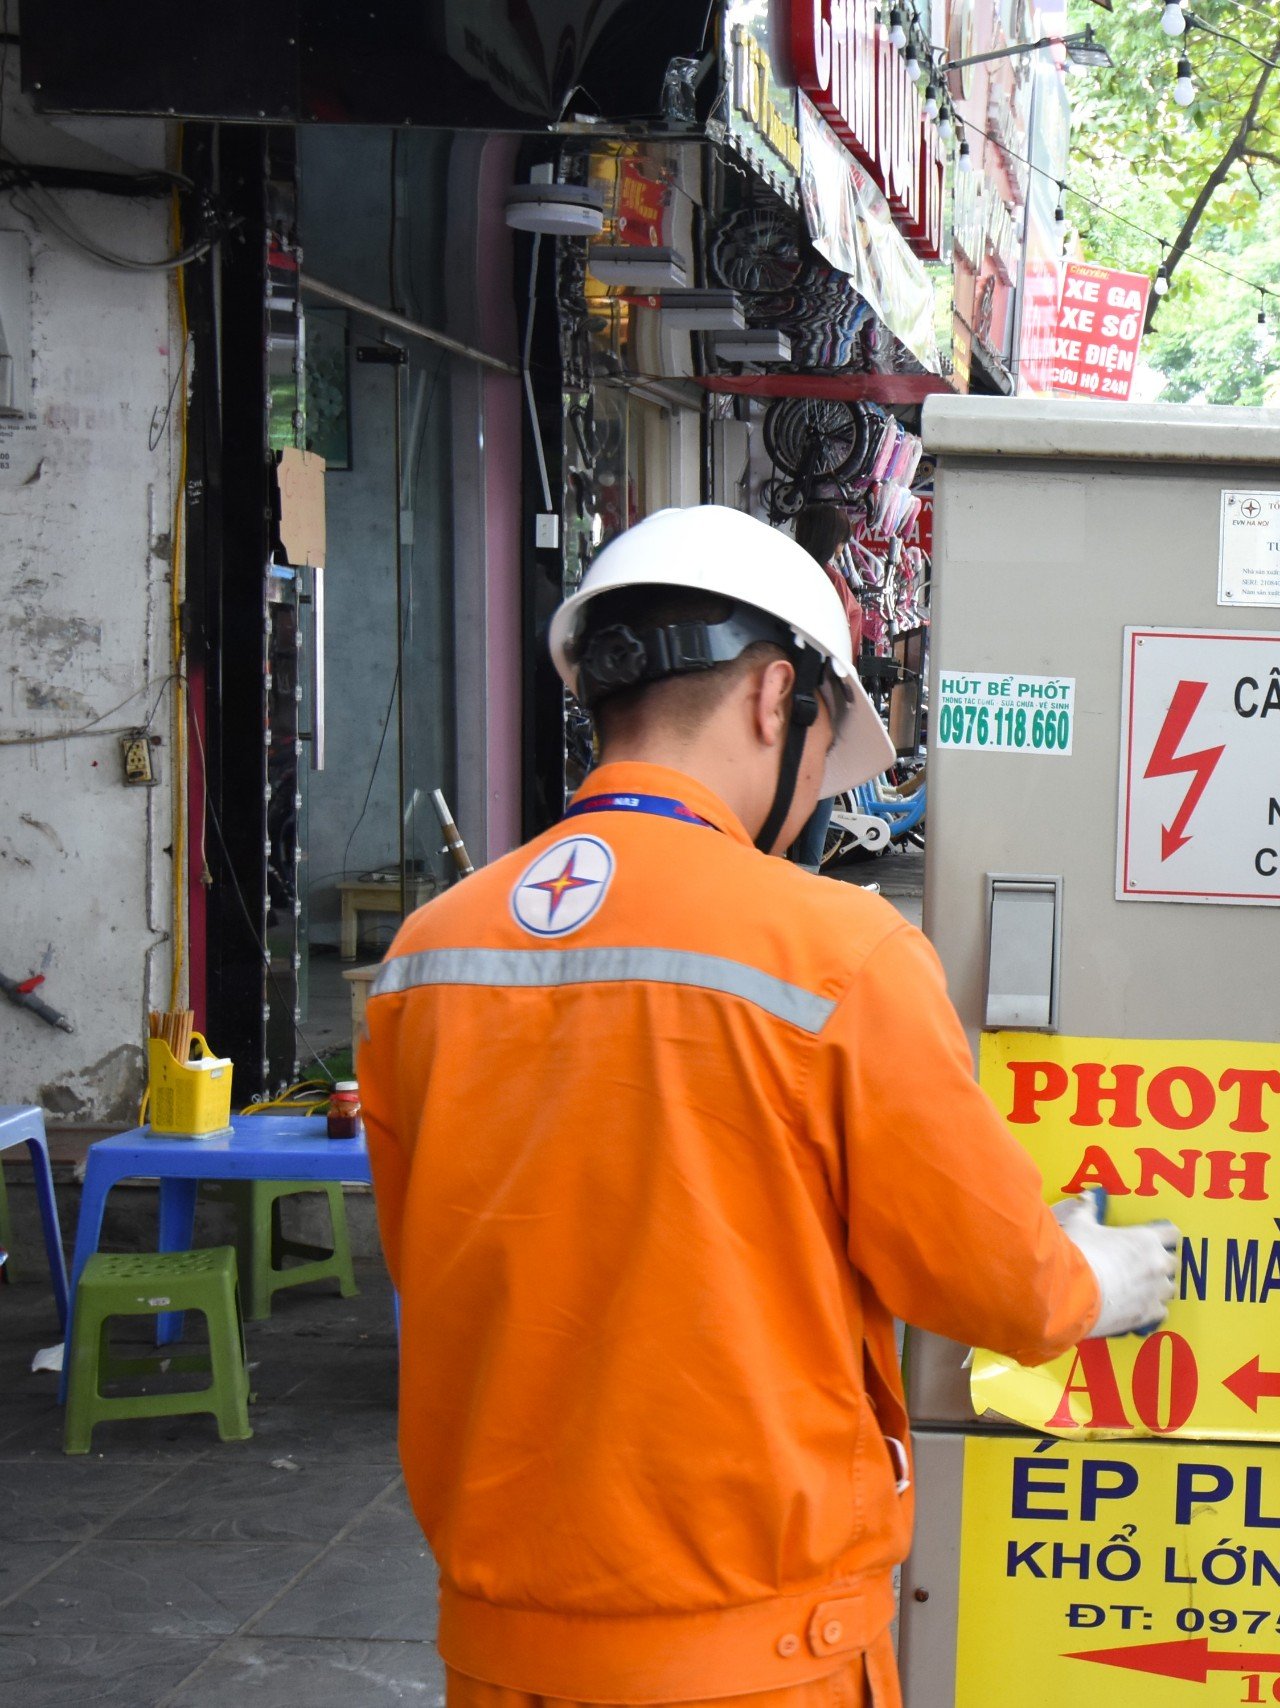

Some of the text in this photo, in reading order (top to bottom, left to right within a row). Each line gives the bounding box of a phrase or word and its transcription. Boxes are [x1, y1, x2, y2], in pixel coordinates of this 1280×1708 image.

[1065, 278, 1142, 311] XE GA
[1060, 306, 1140, 340] XE SỐ
[1054, 337, 1134, 373] XE ĐIỆN
[1080, 372, 1100, 392] HỘ
[1102, 378, 1129, 395] 24H
[942, 676, 1071, 700] HÚT BỂ PHỐT
[1051, 702, 1070, 710] SINH
[940, 704, 1069, 750] 0976.118.660
[1061, 1145, 1271, 1200] ANH
[1011, 1440, 1139, 1522] ÉP
[1006, 1524, 1141, 1582] KHỔ
[1065, 1603, 1153, 1631] ĐT:
